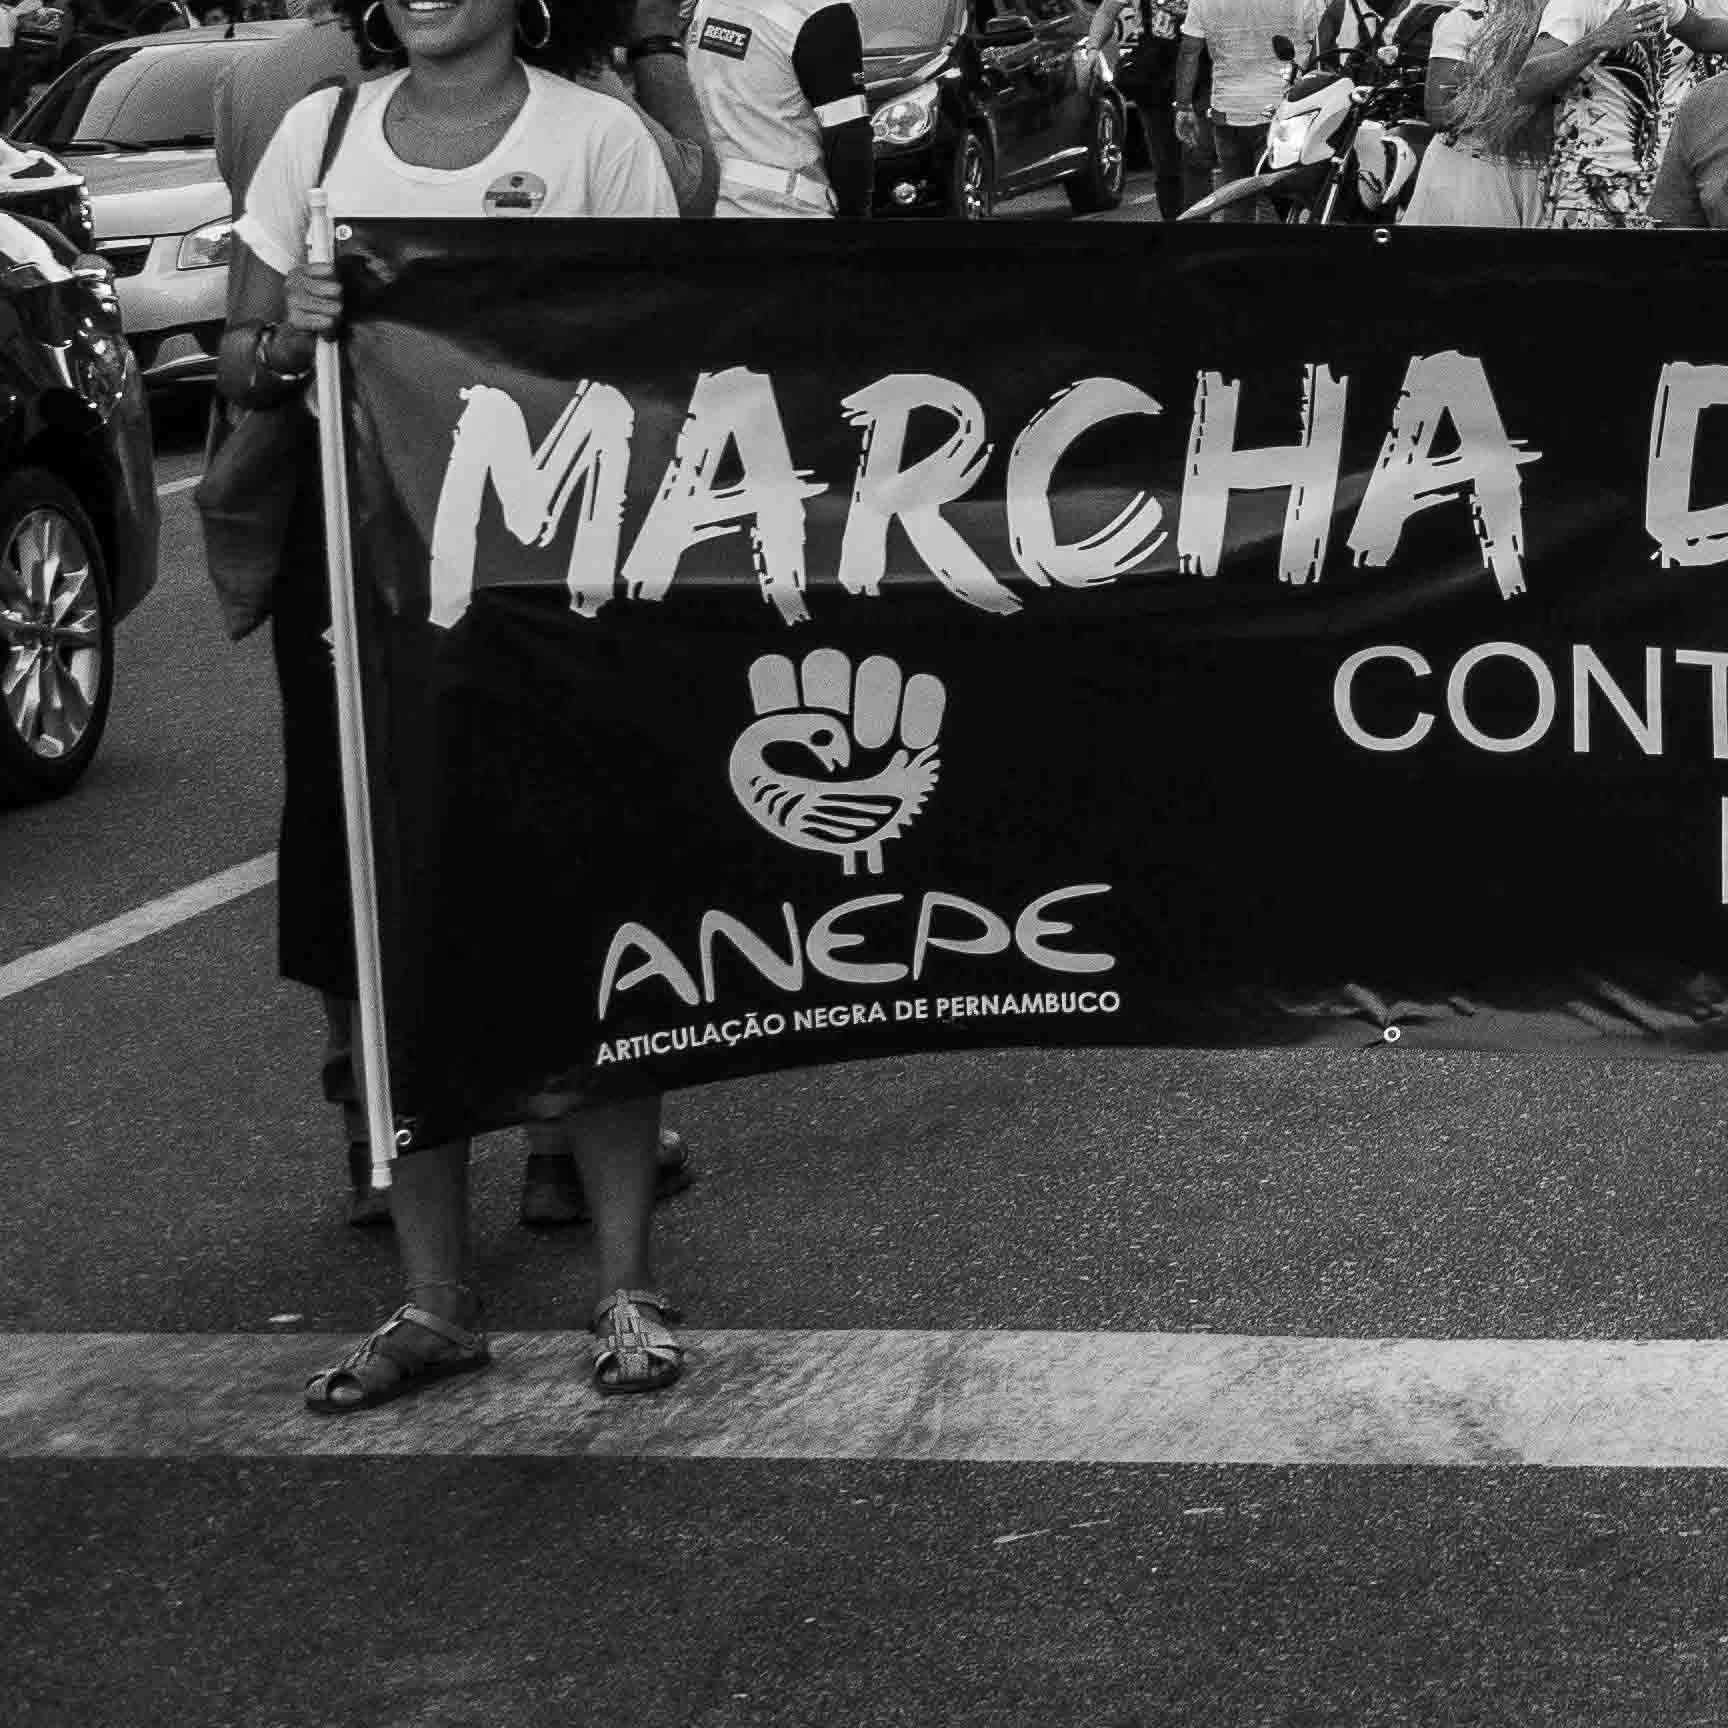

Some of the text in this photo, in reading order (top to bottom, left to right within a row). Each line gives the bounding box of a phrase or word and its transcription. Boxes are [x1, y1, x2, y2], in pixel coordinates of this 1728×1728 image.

[429, 351, 1542, 628] MARCHA
[599, 884, 1116, 1020] ANEPE
[596, 990, 1121, 1065] ARTICULAÇÃO NEGRA DE PERNAMBUCO
